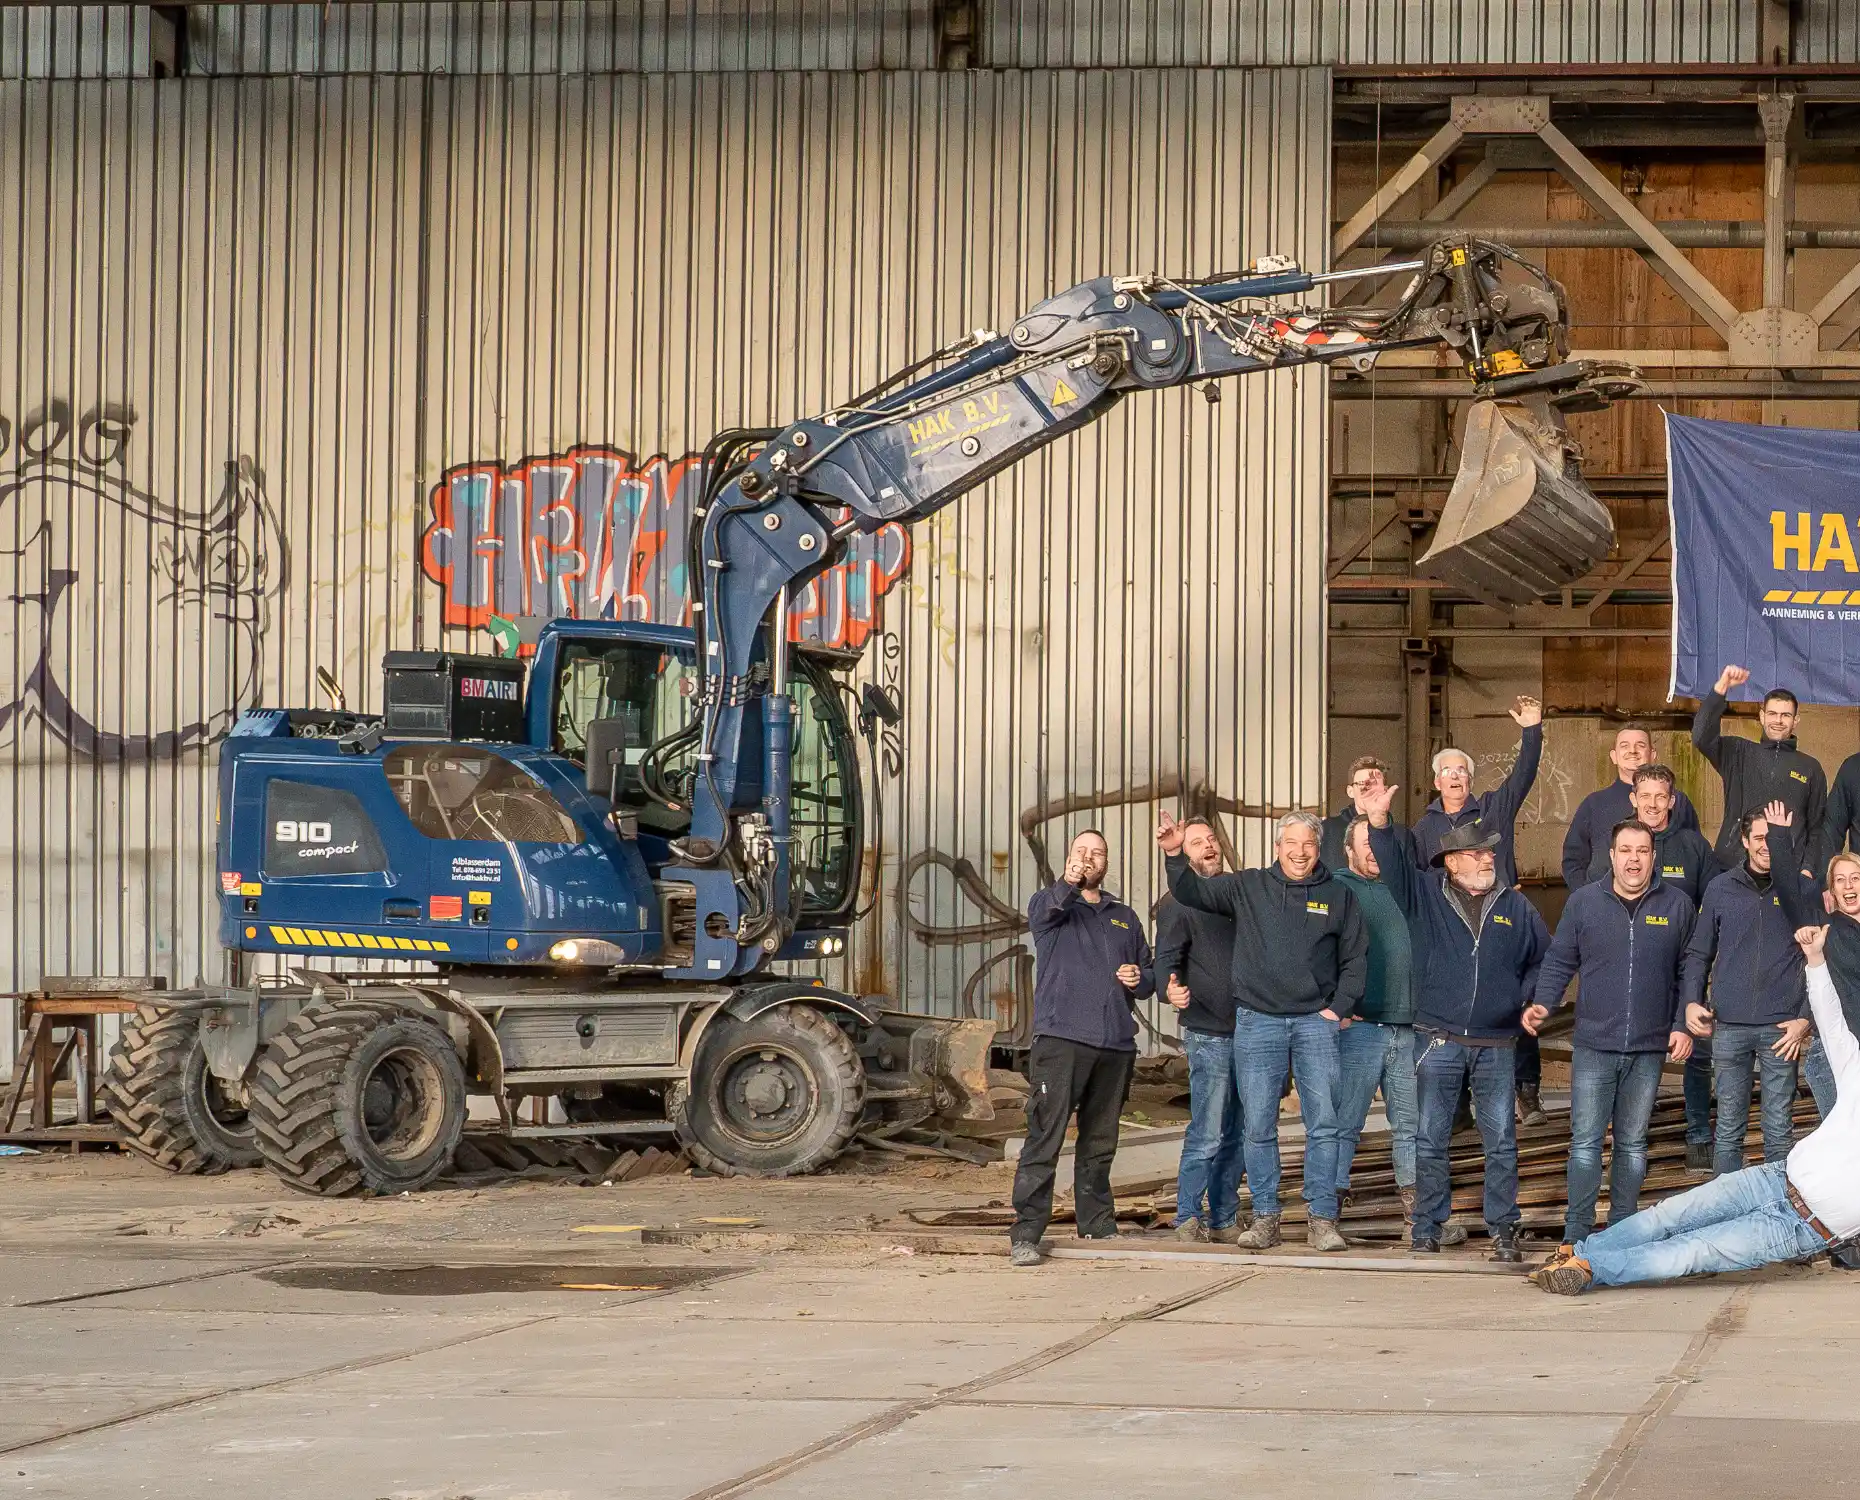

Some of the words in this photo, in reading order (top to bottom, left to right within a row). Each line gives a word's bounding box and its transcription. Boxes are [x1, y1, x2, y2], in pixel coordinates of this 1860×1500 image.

[908, 409, 955, 444] HAK
[963, 391, 1009, 423] B.V.
[1762, 607, 1824, 620] AANNEMING
[1827, 611, 1835, 620] &
[461, 678, 512, 700] BMAIR
[276, 821, 331, 843] 910
[298, 840, 359, 858] compact
[452, 857, 500, 866] Alblasserdam
